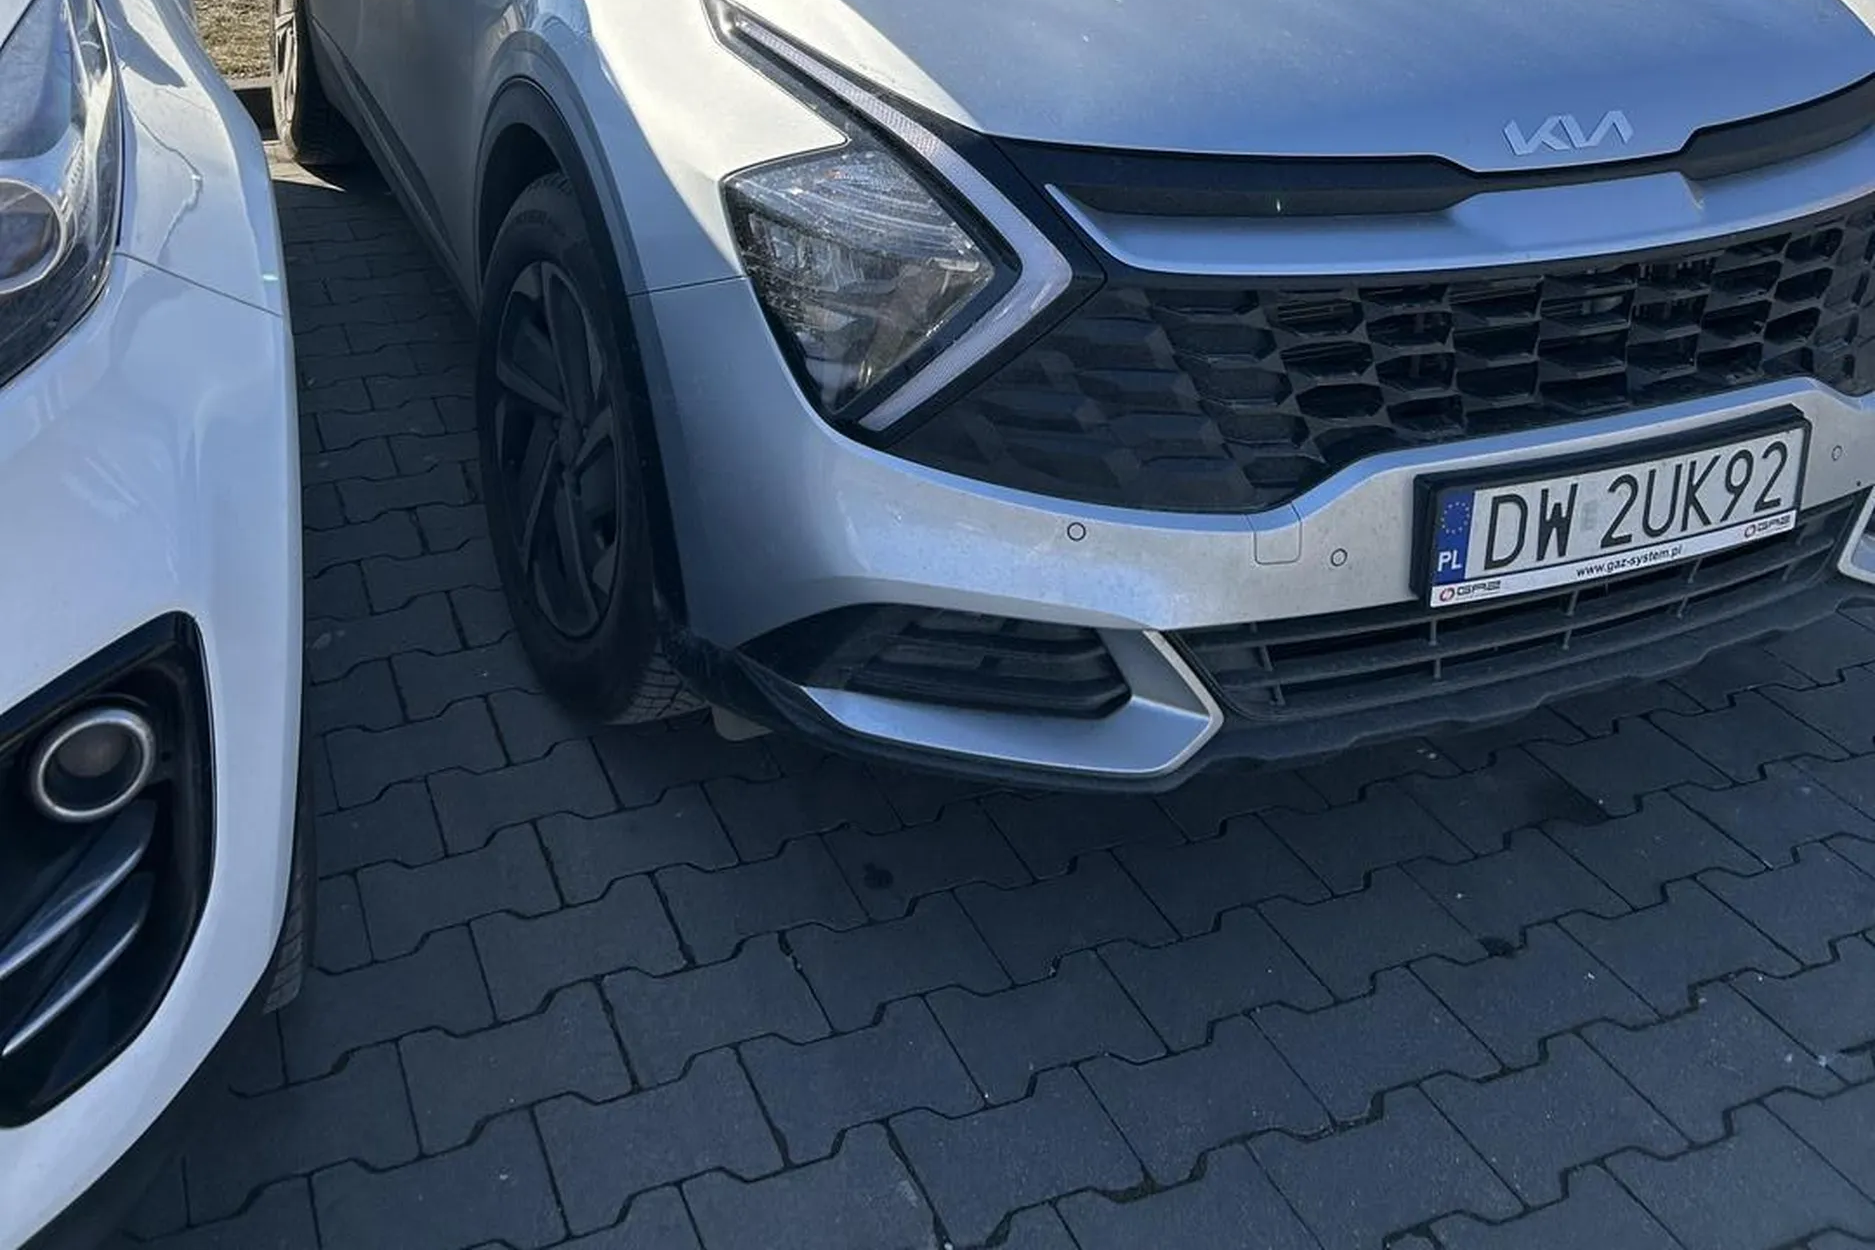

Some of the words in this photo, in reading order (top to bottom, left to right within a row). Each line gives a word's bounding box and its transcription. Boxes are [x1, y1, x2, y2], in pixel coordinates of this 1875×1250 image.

[1483, 483, 1579, 571] DW
[1600, 440, 1789, 549] 2UK92
[1437, 549, 1463, 573] PL
[1576, 544, 1683, 578] www.gaz-system.pl
